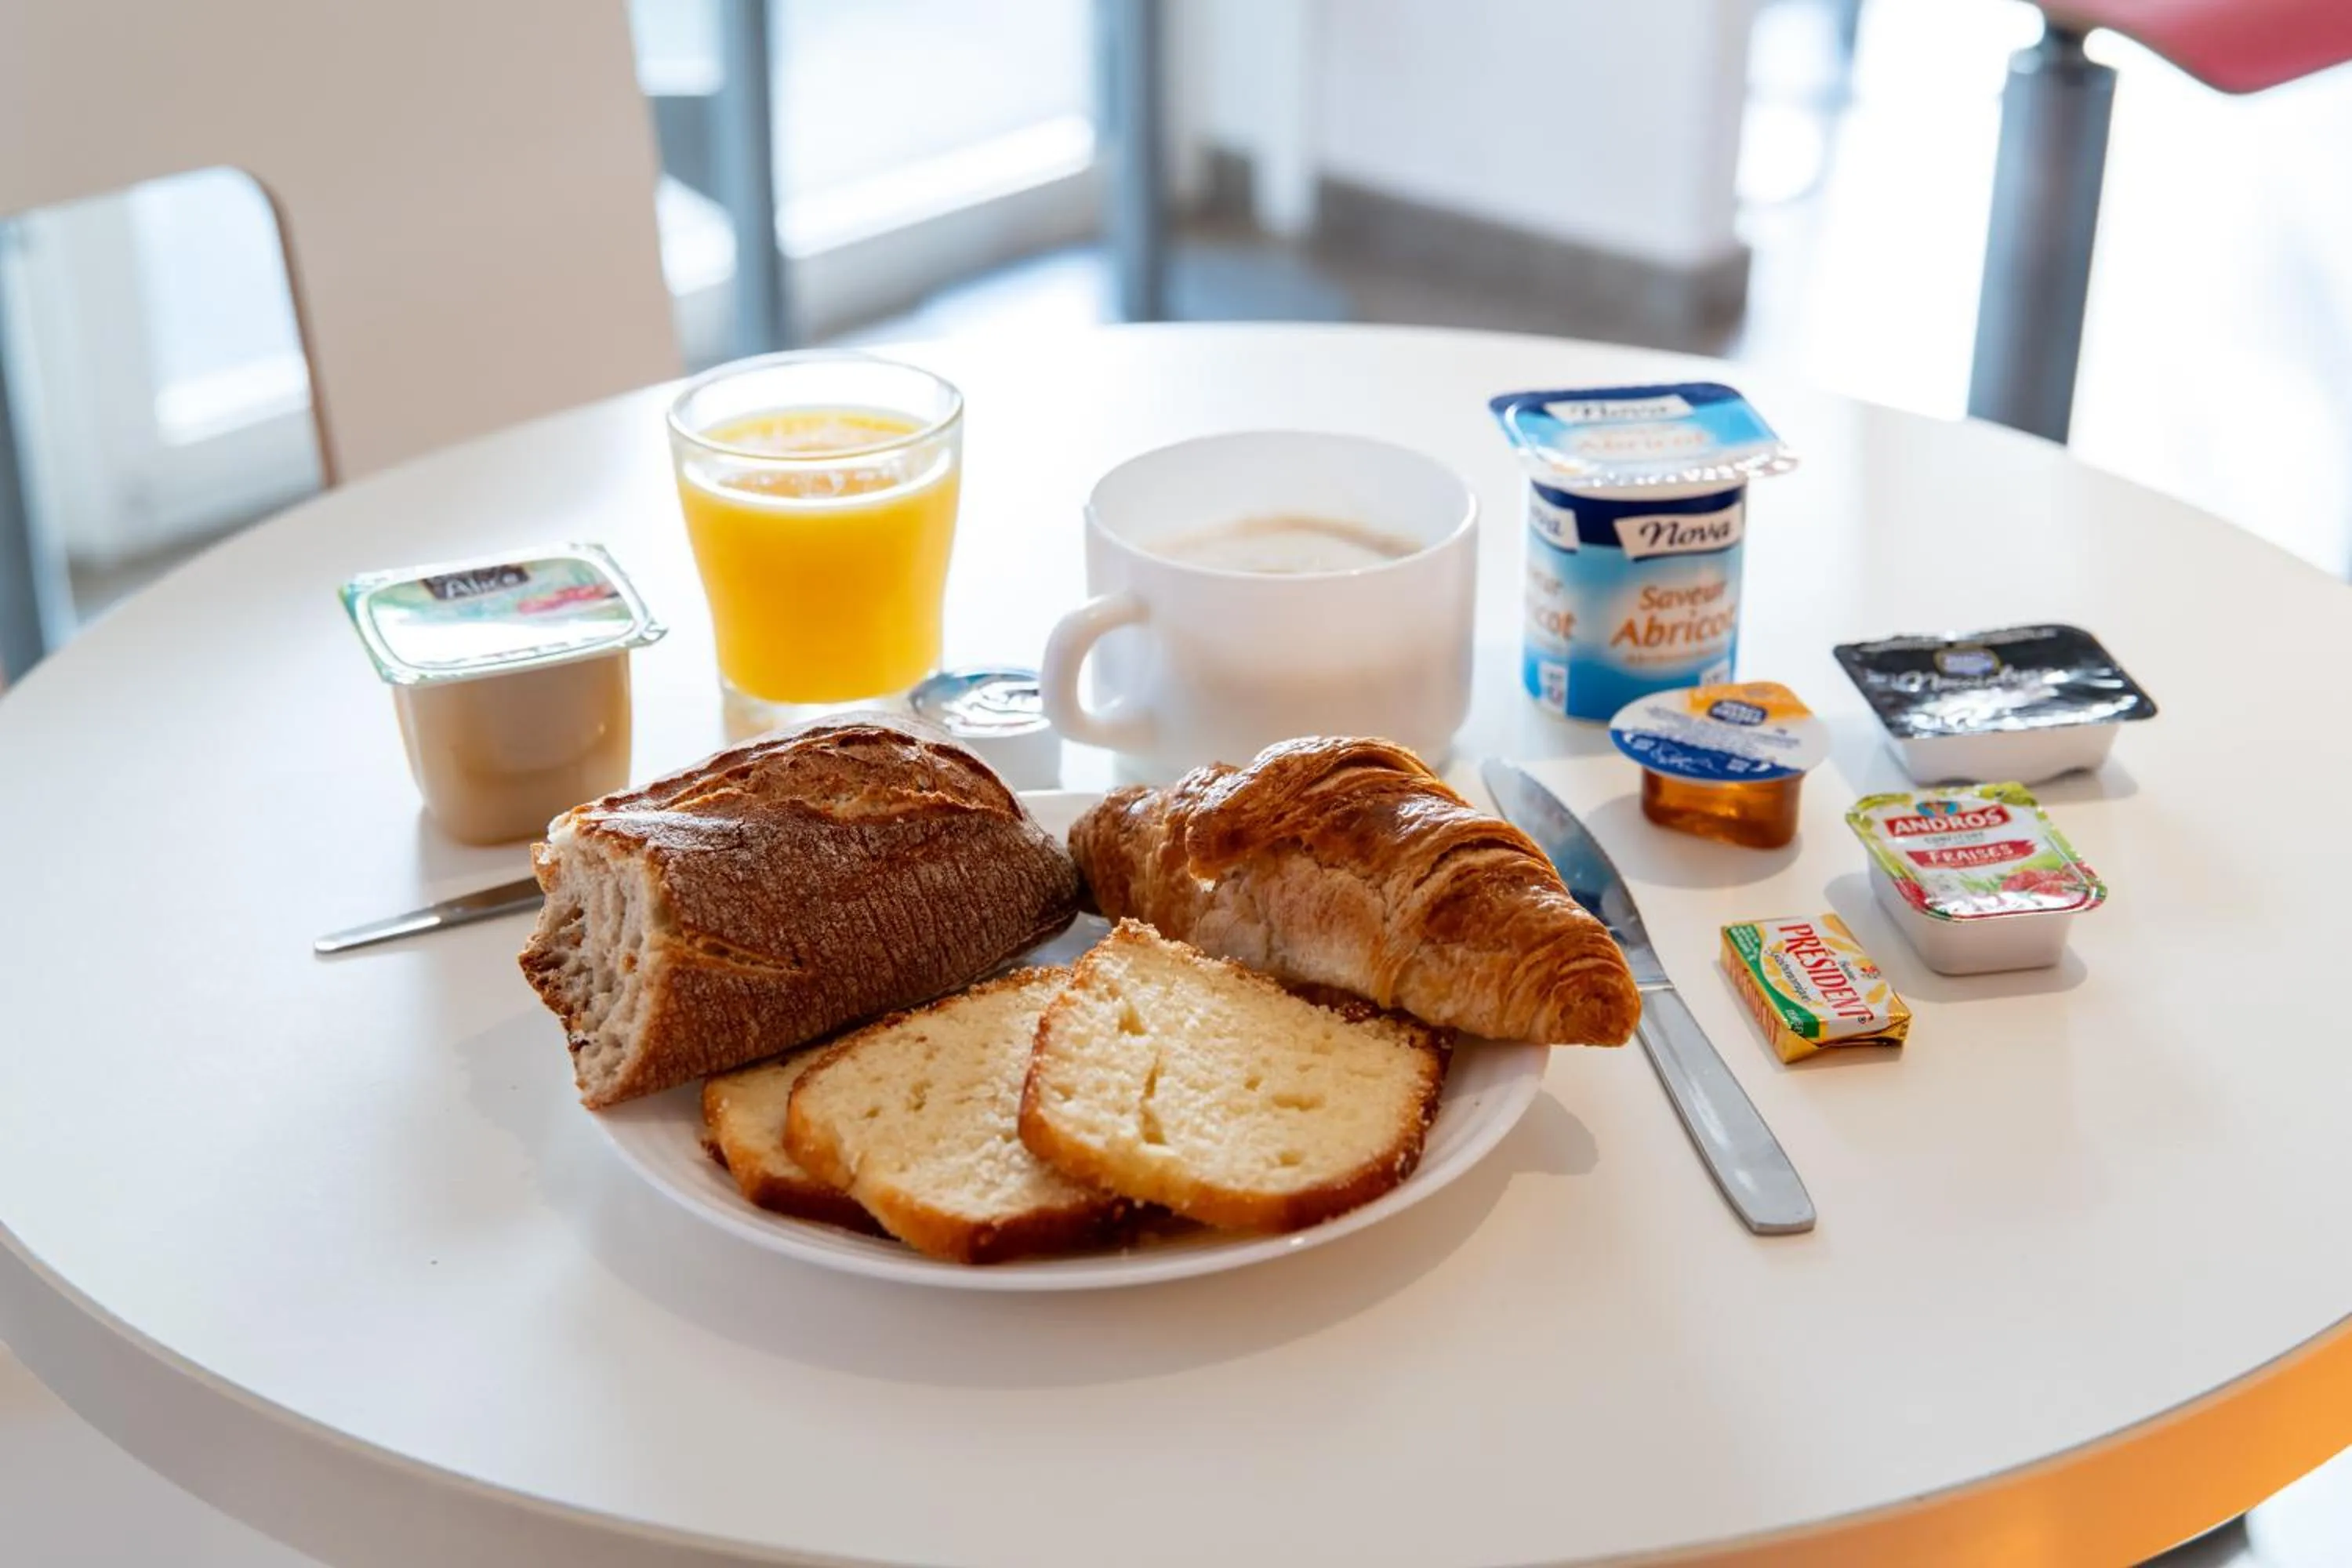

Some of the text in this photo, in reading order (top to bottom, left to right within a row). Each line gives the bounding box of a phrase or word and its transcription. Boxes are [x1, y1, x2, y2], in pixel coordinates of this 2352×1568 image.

[1639, 520, 1731, 547] Nova
[1639, 579, 1727, 611] Saveur
[1610, 602, 1735, 648] Abricot
[1894, 809, 2002, 836] ANDROS
[1928, 844, 2015, 863] FRAISES
[1778, 924, 1875, 1021] PRÉSIDENT
